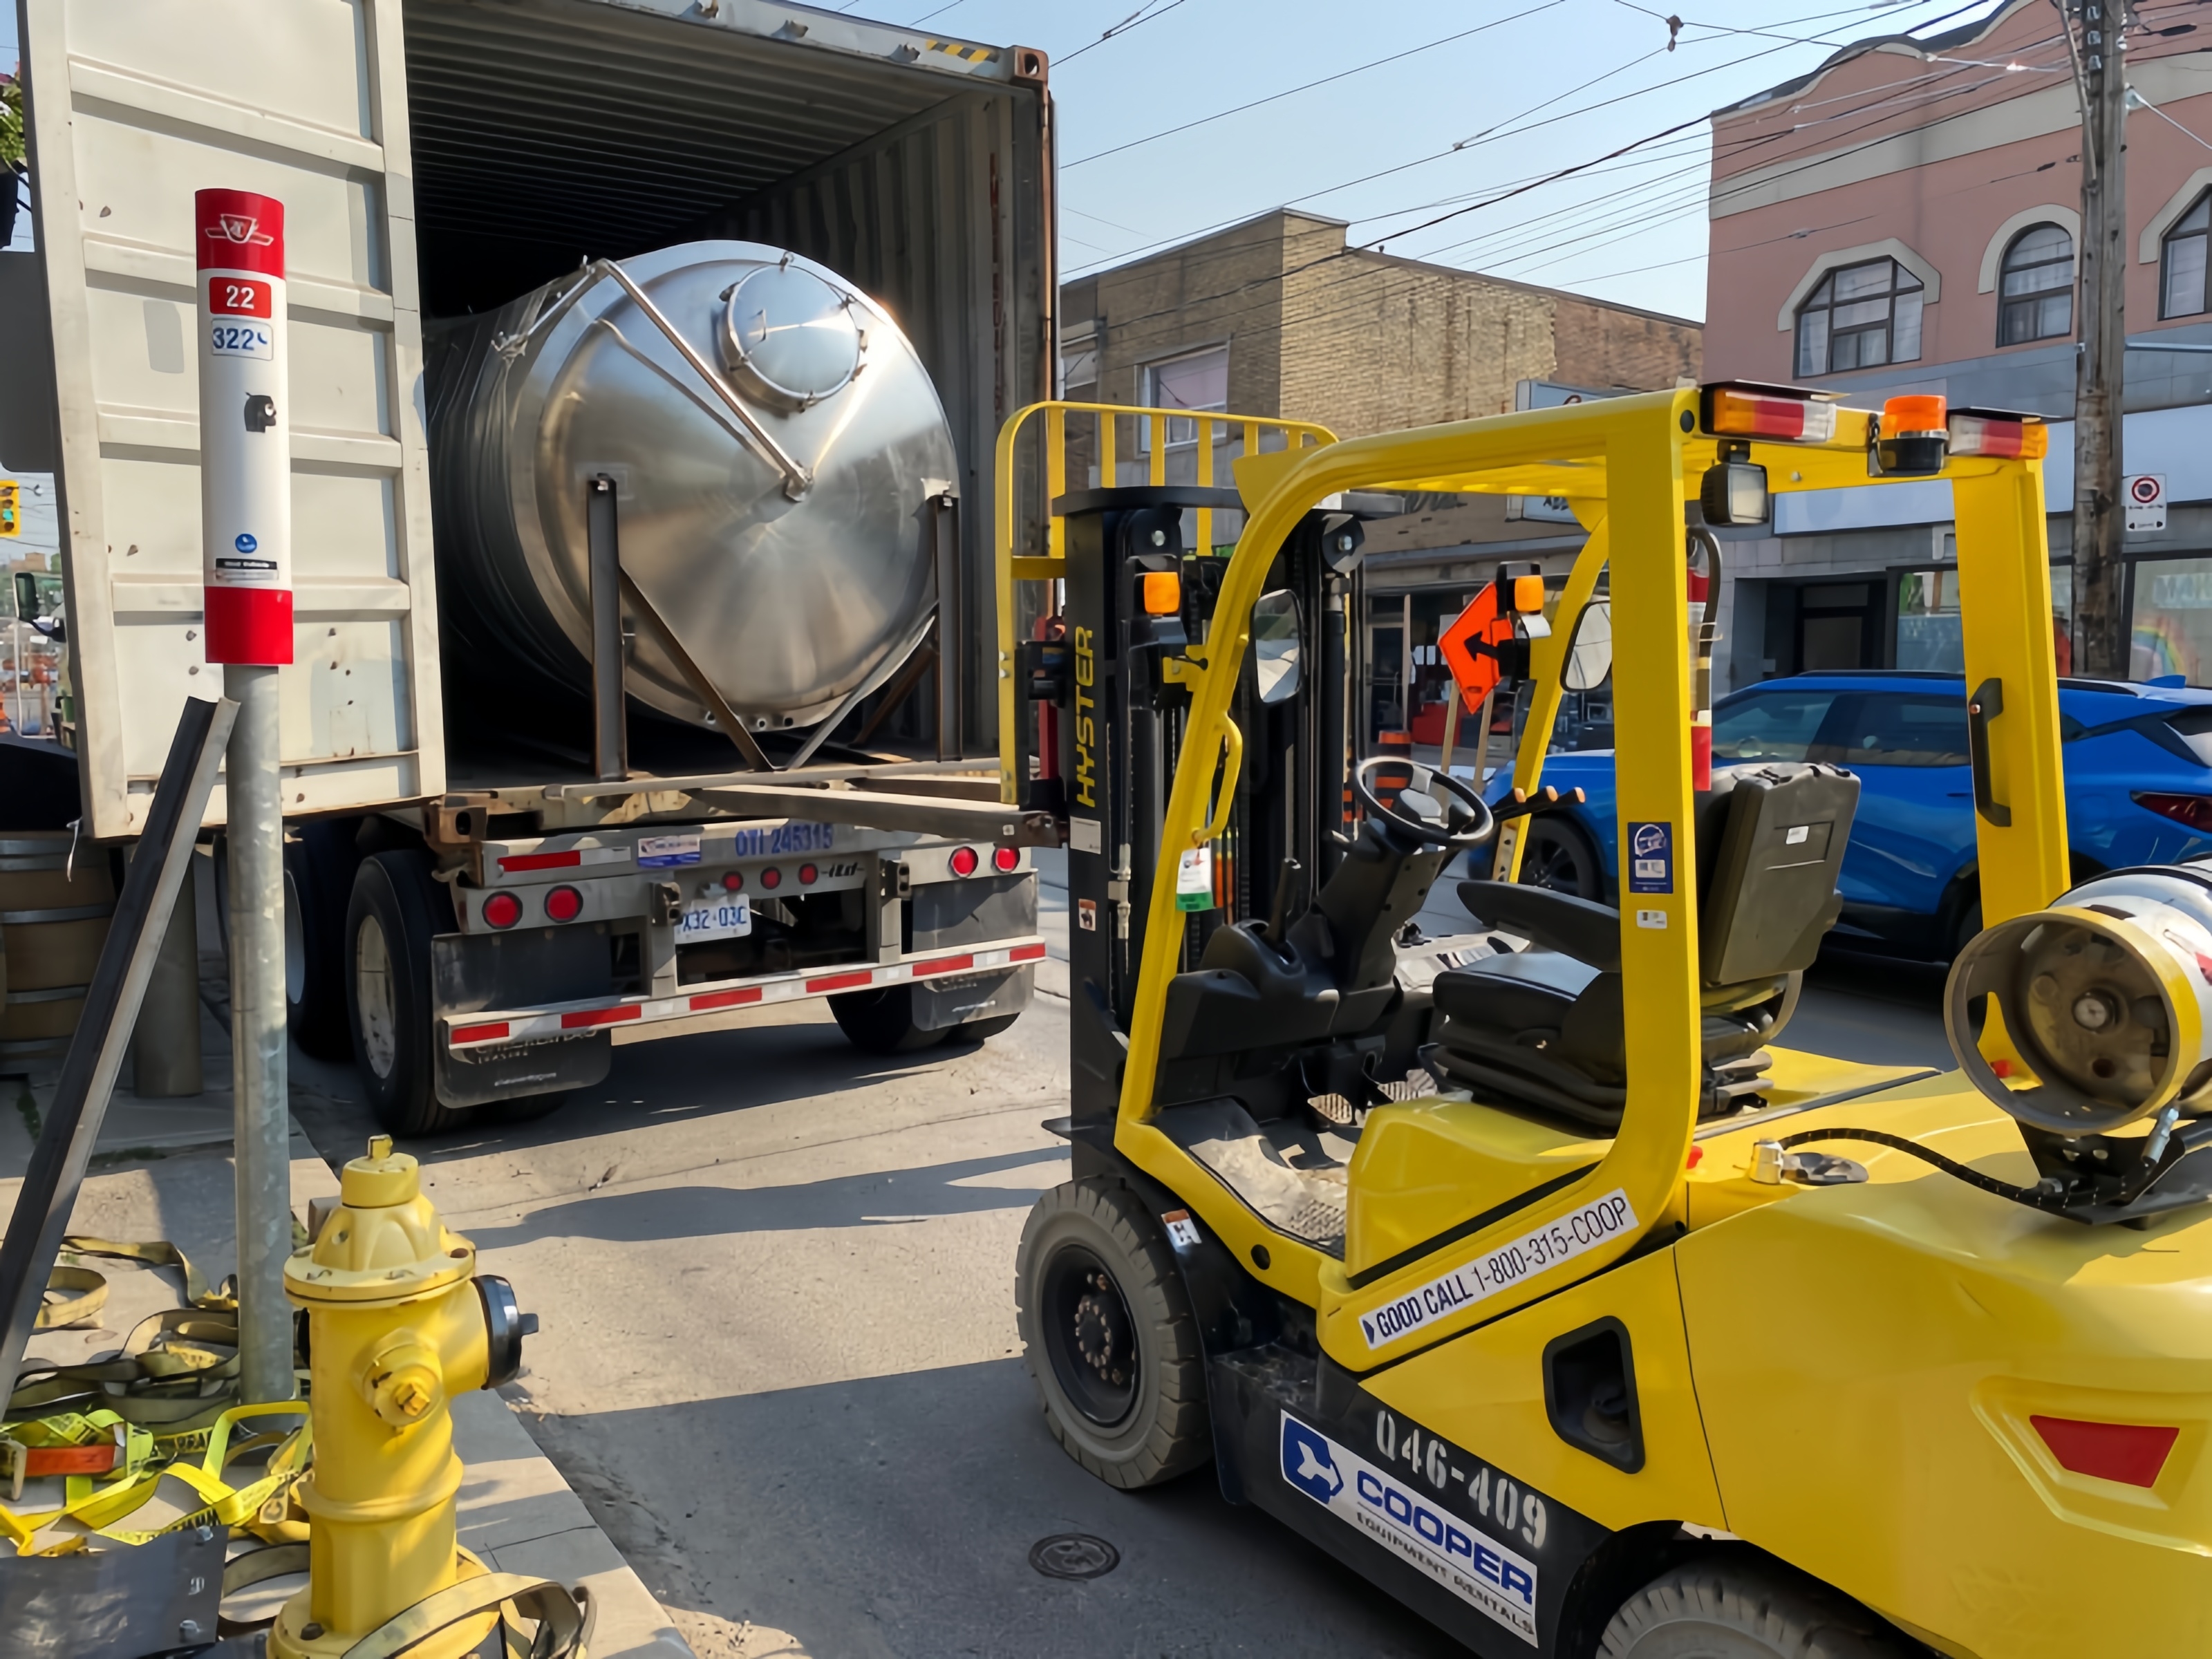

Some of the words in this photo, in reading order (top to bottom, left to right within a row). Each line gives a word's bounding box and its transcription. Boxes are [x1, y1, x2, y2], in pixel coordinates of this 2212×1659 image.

[213, 328, 254, 351] 322
[227, 285, 255, 310] 22
[1076, 626, 1095, 808] HYSTER
[1376, 1296, 1423, 1338] GOOD
[1423, 1274, 1474, 1315] CALL
[1471, 1196, 1627, 1292] 1-800-315-COOP
[1356, 1512, 1447, 1578] EQUIPMENT
[1454, 1575, 1535, 1635] RENTALS
[1357, 1470, 1533, 1605] COOPER
